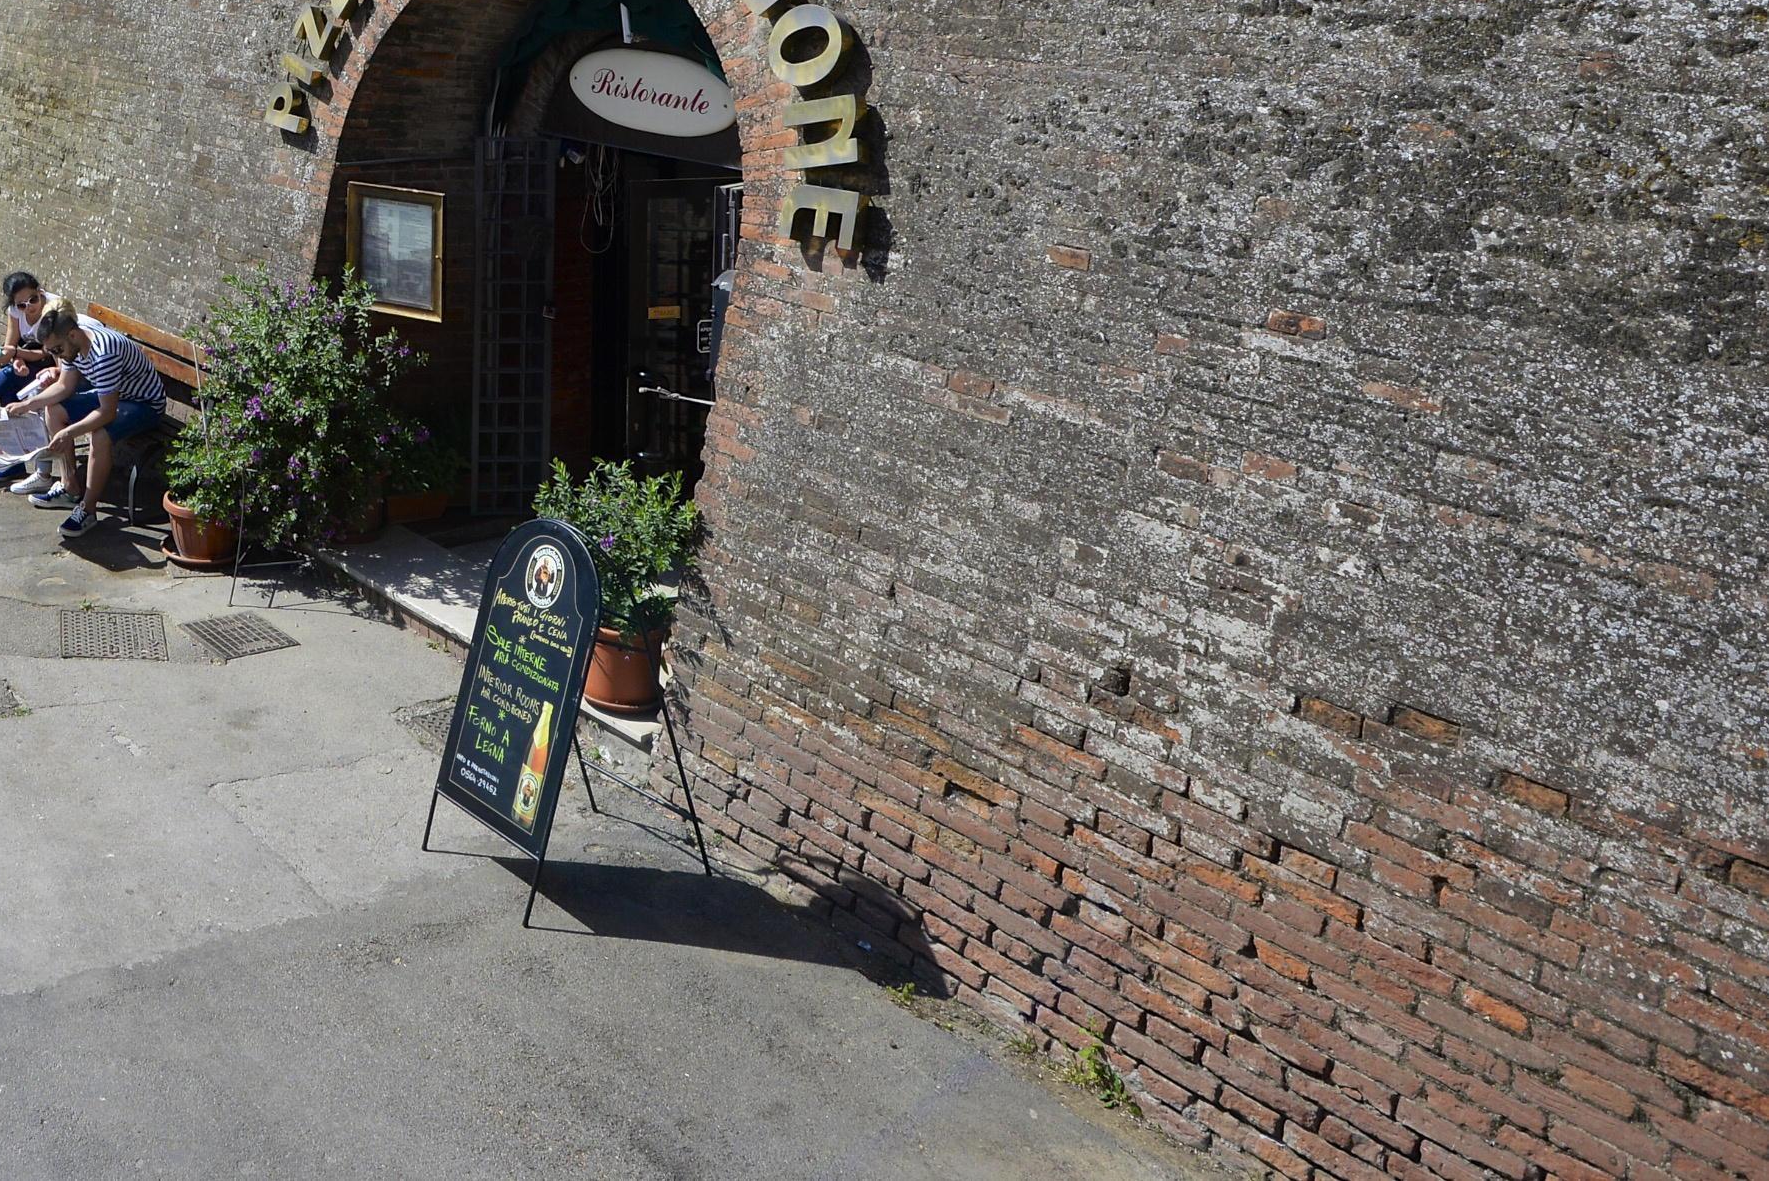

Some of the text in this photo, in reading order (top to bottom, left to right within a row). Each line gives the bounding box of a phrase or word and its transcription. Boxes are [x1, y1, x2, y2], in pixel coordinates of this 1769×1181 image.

[591, 68, 710, 115] Ristorante
[538, 624, 545, 633] E
[548, 626, 568, 642] CENA
[514, 644, 547, 672] INTERNE
[478, 663, 541, 716] INTERIOR ROOMS
[511, 659, 560, 694] CONDIZIONATA
[475, 732, 505, 764] LEGNA
[501, 729, 510, 748] A
